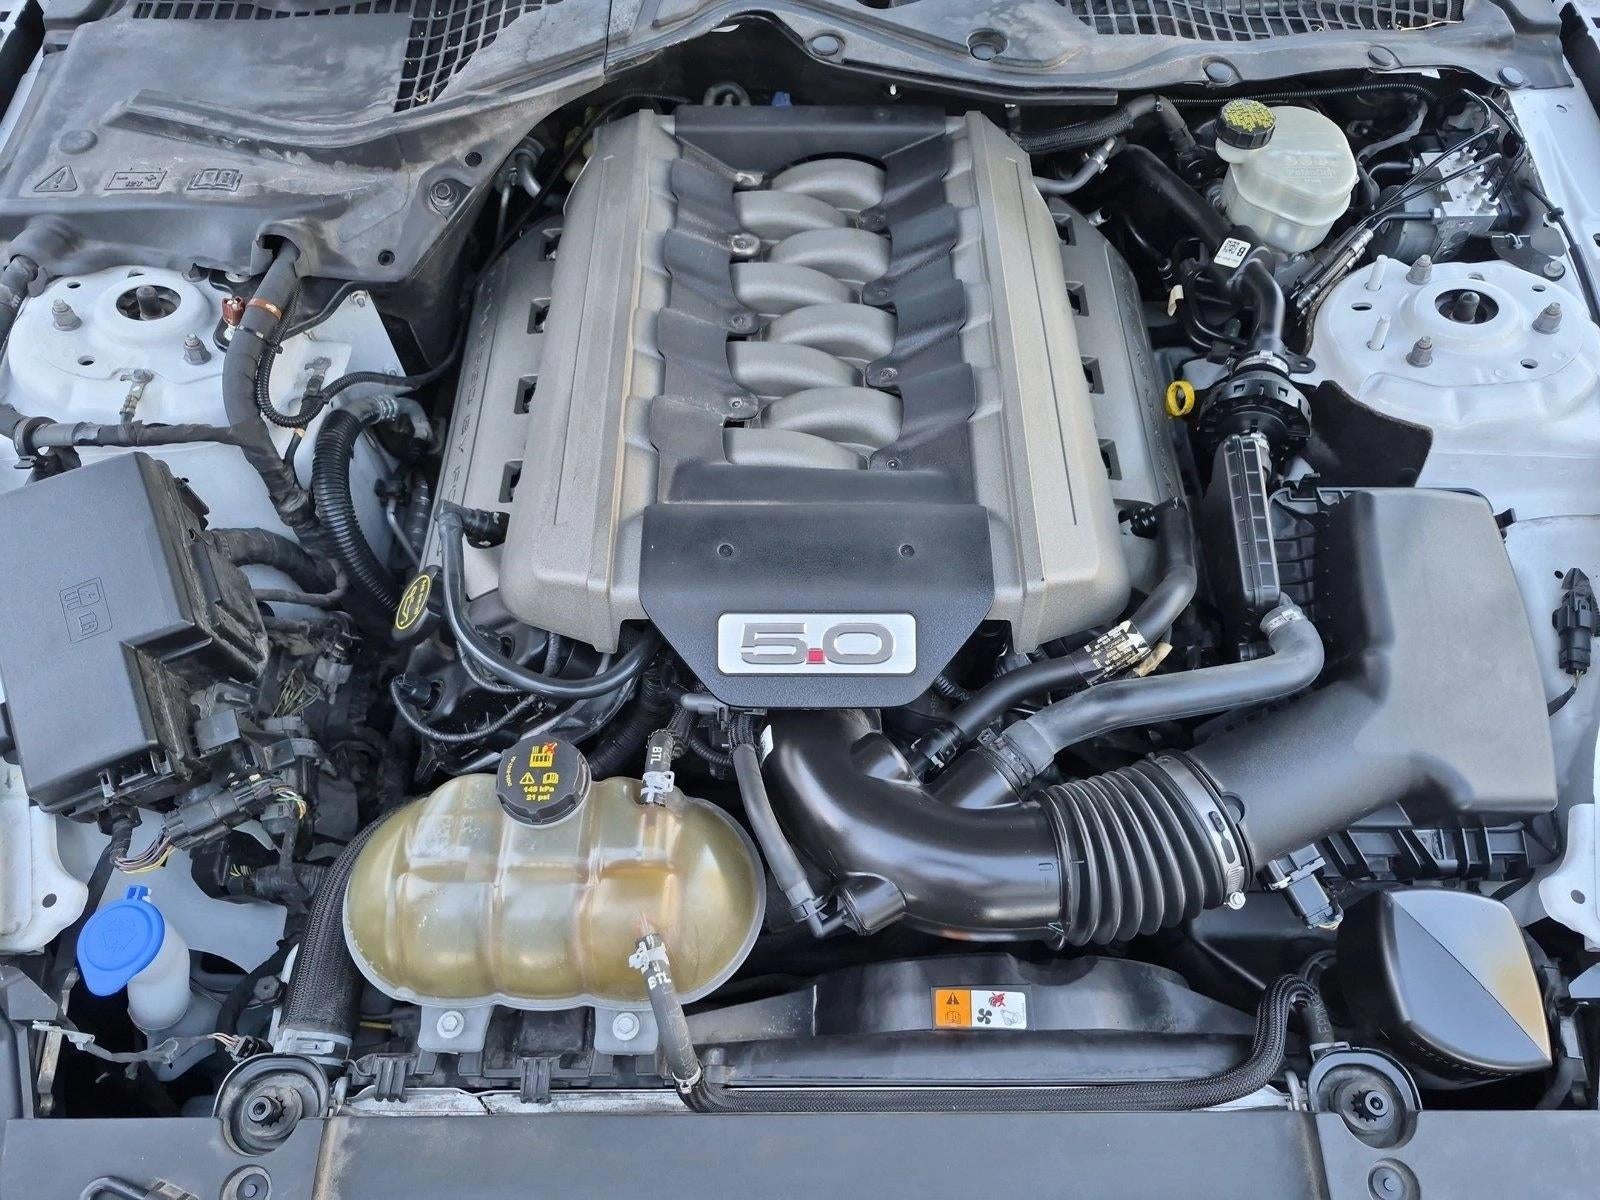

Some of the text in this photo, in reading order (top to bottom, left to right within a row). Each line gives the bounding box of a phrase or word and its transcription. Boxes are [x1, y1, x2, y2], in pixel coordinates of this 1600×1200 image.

[740, 622, 894, 665] 5.0
[650, 746, 663, 765] BTL
[648, 971, 672, 990] BTL
